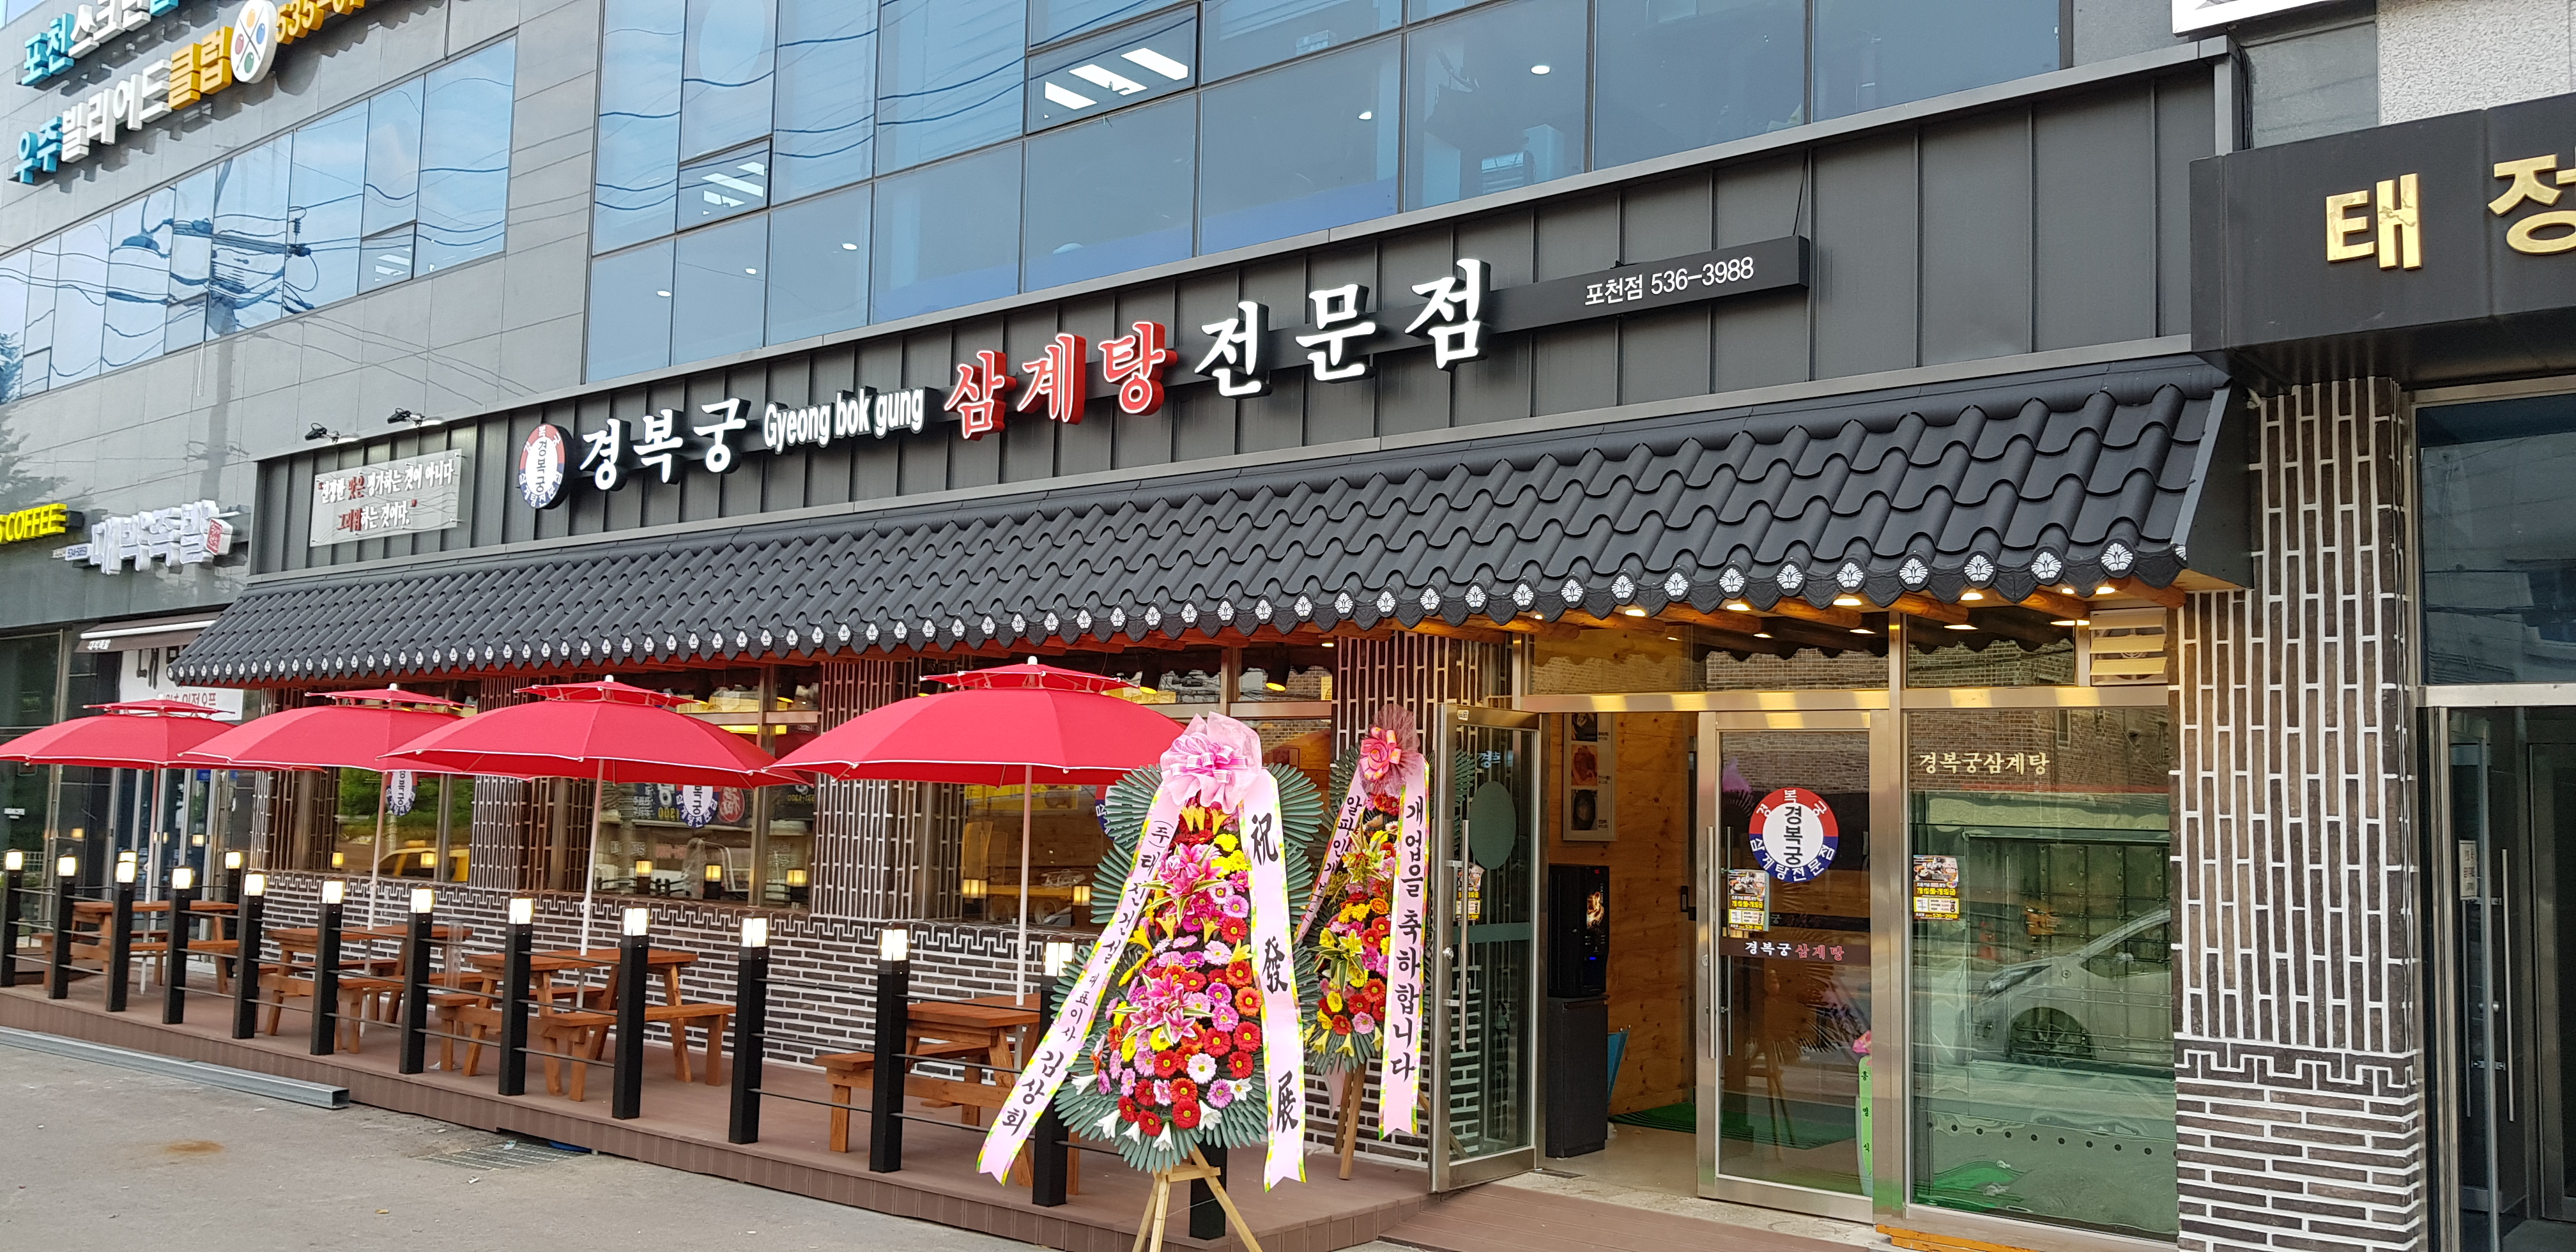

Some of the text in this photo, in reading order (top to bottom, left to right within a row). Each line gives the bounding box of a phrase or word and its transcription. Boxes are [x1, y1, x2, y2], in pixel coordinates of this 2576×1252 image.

[1584, 256, 1754, 305] 포천점 536-3988
[944, 257, 1491, 441] 삼계탕 전문점
[579, 397, 749, 491] 경복궁
[763, 386, 926, 454] Gyeong bok gung
[403, 464, 423, 491] 것이
[425, 459, 455, 487] 아니다
[536, 439, 548, 494] 경복궁
[6, 503, 68, 542] COFFEE
[1919, 751, 2051, 775] 경복궁삼계탕
[1756, 789, 1828, 818] 경복궁
[1749, 837, 1836, 882] 삼계탕전문점
[1783, 805, 1804, 866] 경복궁
[1390, 795, 1424, 1083] 개업을 축하합니다
[1744, 940, 1792, 957] 경복궁
[1001, 1050, 1065, 1137] 김상회
